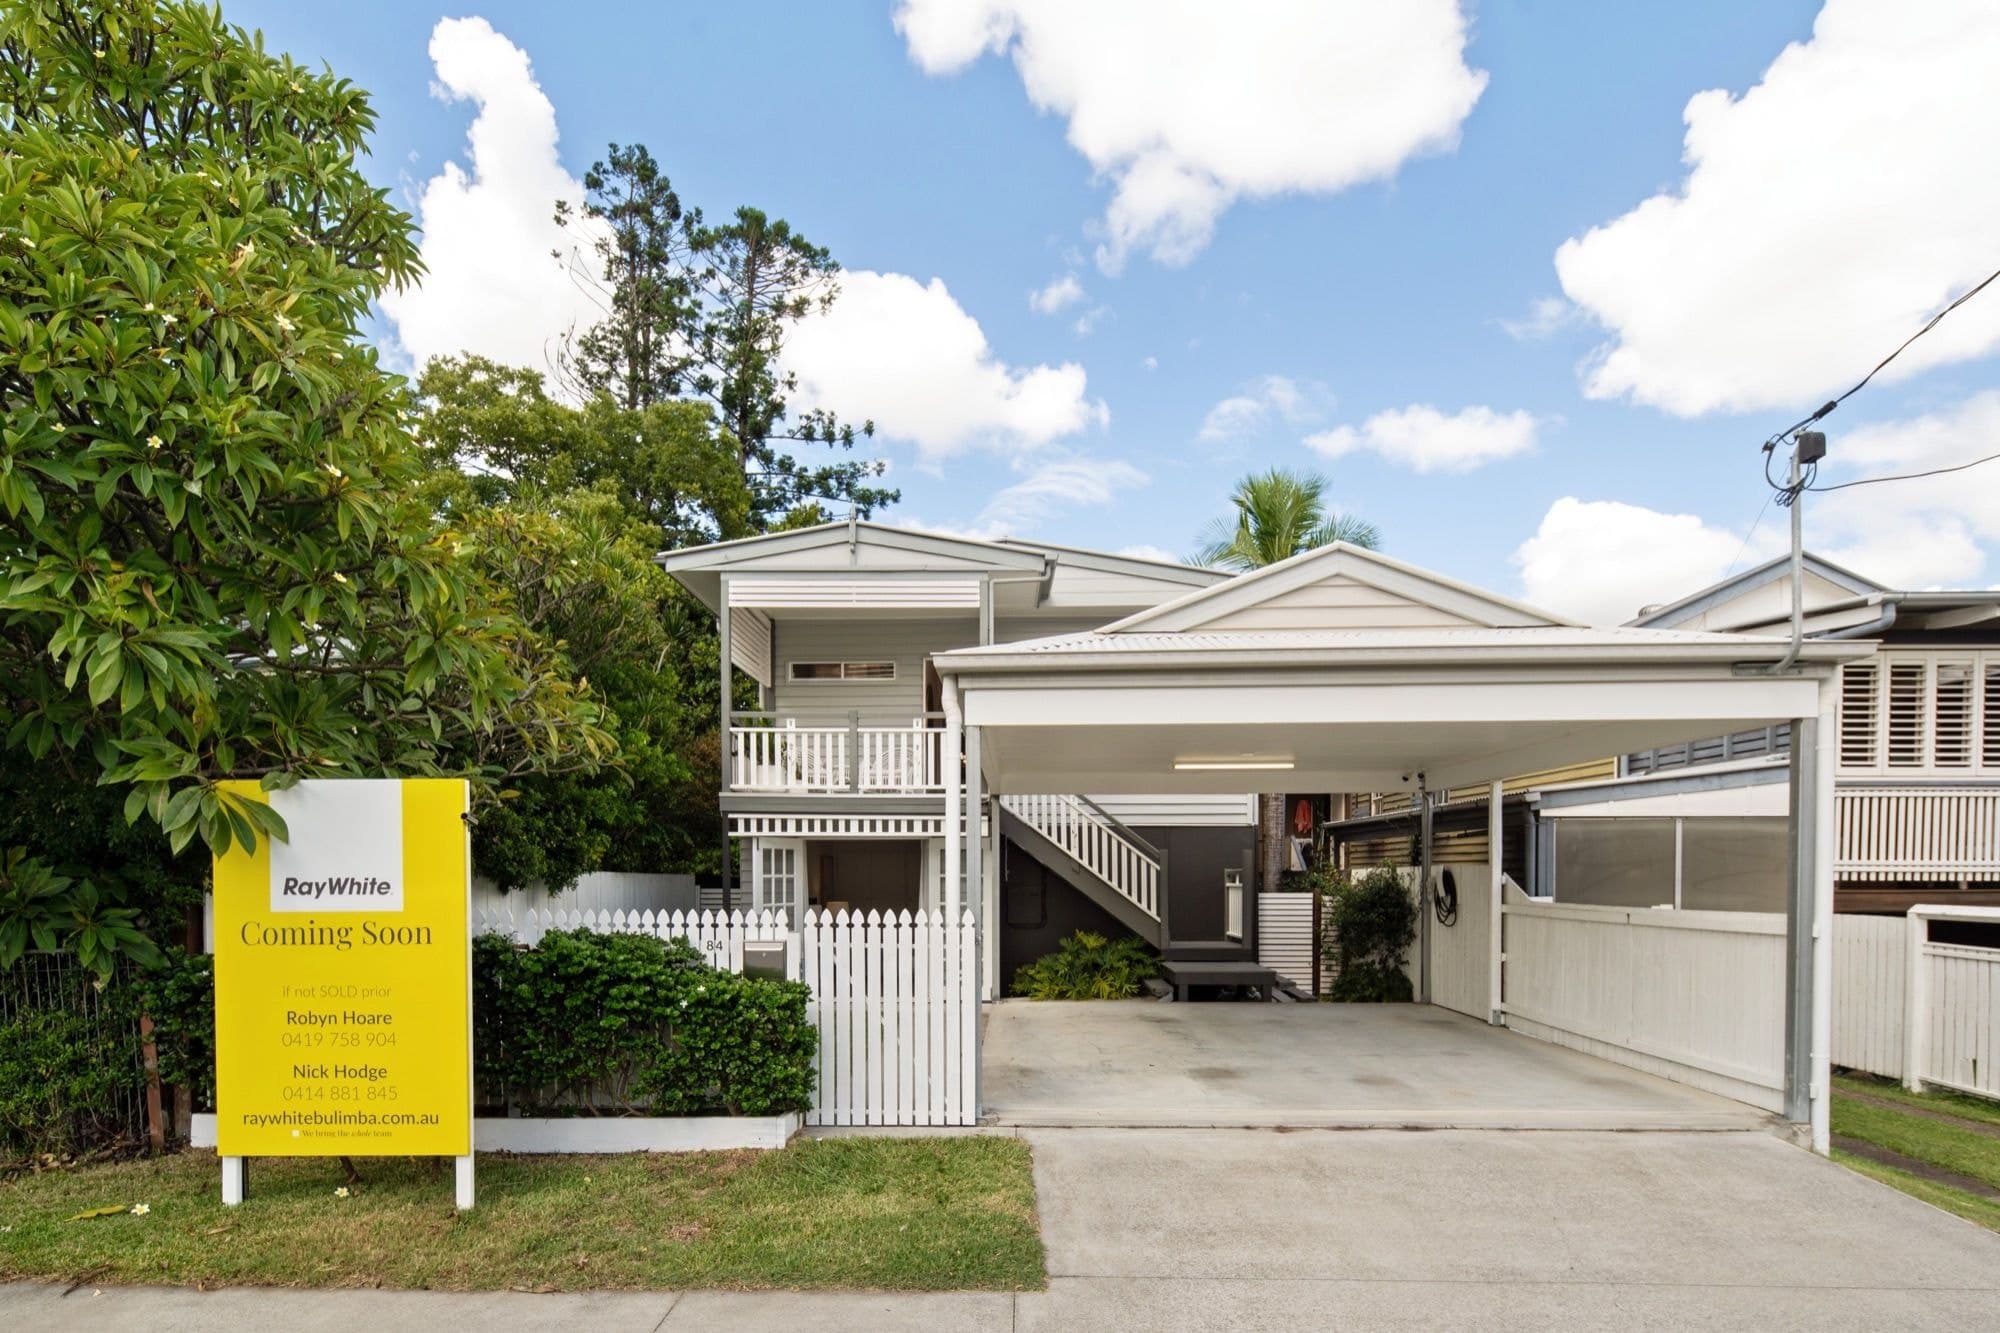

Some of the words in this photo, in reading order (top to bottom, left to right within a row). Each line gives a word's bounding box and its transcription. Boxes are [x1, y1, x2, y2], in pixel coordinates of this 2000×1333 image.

[283, 877, 391, 899] RayWhite
[241, 920, 353, 951] Coming
[362, 920, 432, 945] Soon
[706, 940, 723, 951] 84
[282, 984, 291, 998] if
[294, 985, 315, 998] not
[320, 984, 357, 998] SOLD
[361, 984, 391, 1002] prior
[286, 1010, 337, 1029] Robyn
[343, 1010, 392, 1025] Hoare
[281, 1032, 323, 1047] 0419
[330, 1032, 360, 1047] 758
[366, 1032, 396, 1047] 904
[293, 1064, 329, 1079] Nick
[335, 1064, 387, 1082] Hodge
[282, 1086, 325, 1101] 0414
[330, 1086, 360, 1101] 881
[366, 1086, 398, 1101] 845
[243, 1110, 440, 1128] raywhitebulimba.com.au
[302, 1129, 314, 1137] We
[315, 1129, 336, 1138] bring
[337, 1129, 350, 1137] the
[350, 1129, 371, 1137] whole
